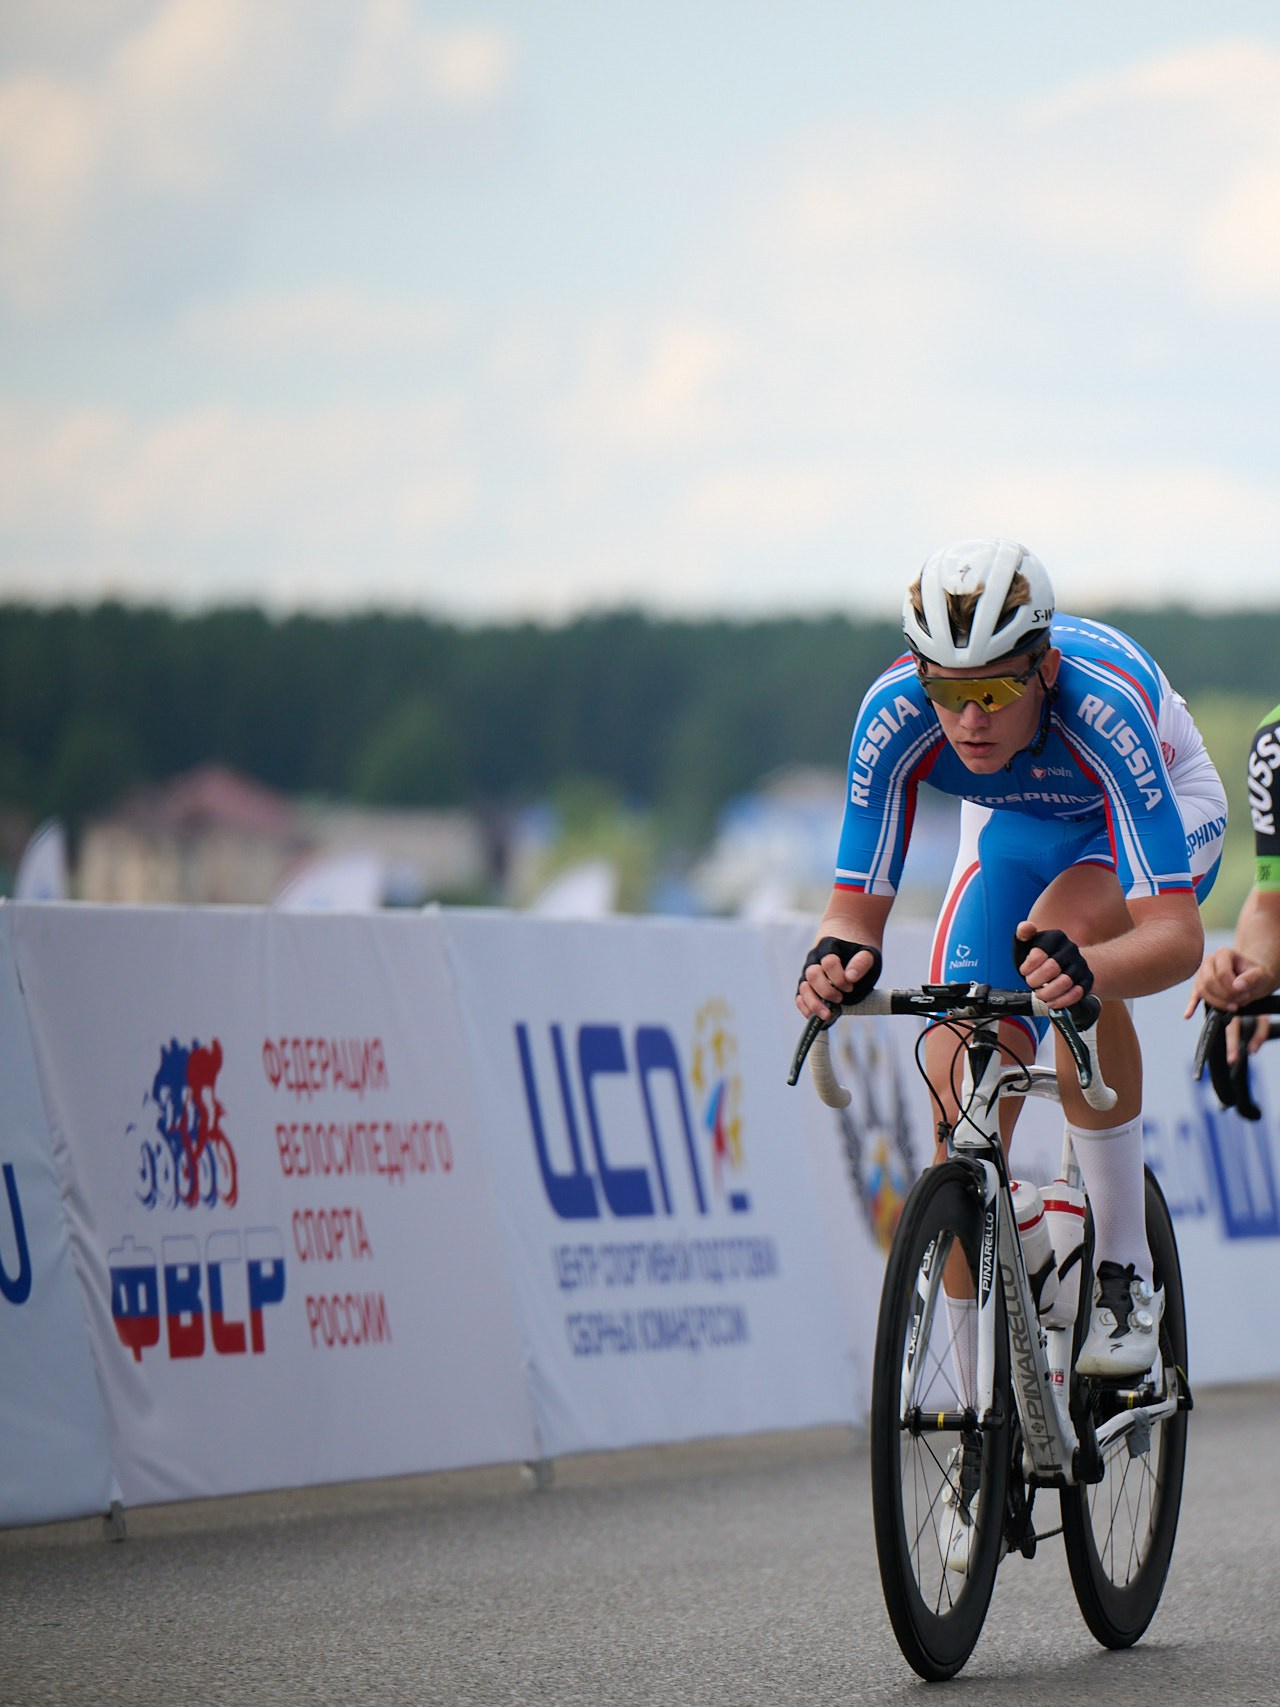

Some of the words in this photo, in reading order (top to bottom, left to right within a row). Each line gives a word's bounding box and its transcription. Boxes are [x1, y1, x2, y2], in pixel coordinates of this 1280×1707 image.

[850, 695, 921, 808] RUSSIA
[1077, 693, 1163, 811] RUSSIA
[949, 959, 979, 970] Nalini
[262, 1036, 389, 1100] ФЕДЕРАЦИЯ
[275, 1120, 454, 1184] ВЕЛОСИПЕДНОГО
[513, 1021, 710, 1220] ЦСП
[292, 1207, 373, 1263] СПОРТА
[981, 1211, 995, 1292] PINARELLO
[305, 1293, 392, 1350] РОССИИ
[1000, 1263, 1045, 1420] PINARELLO
